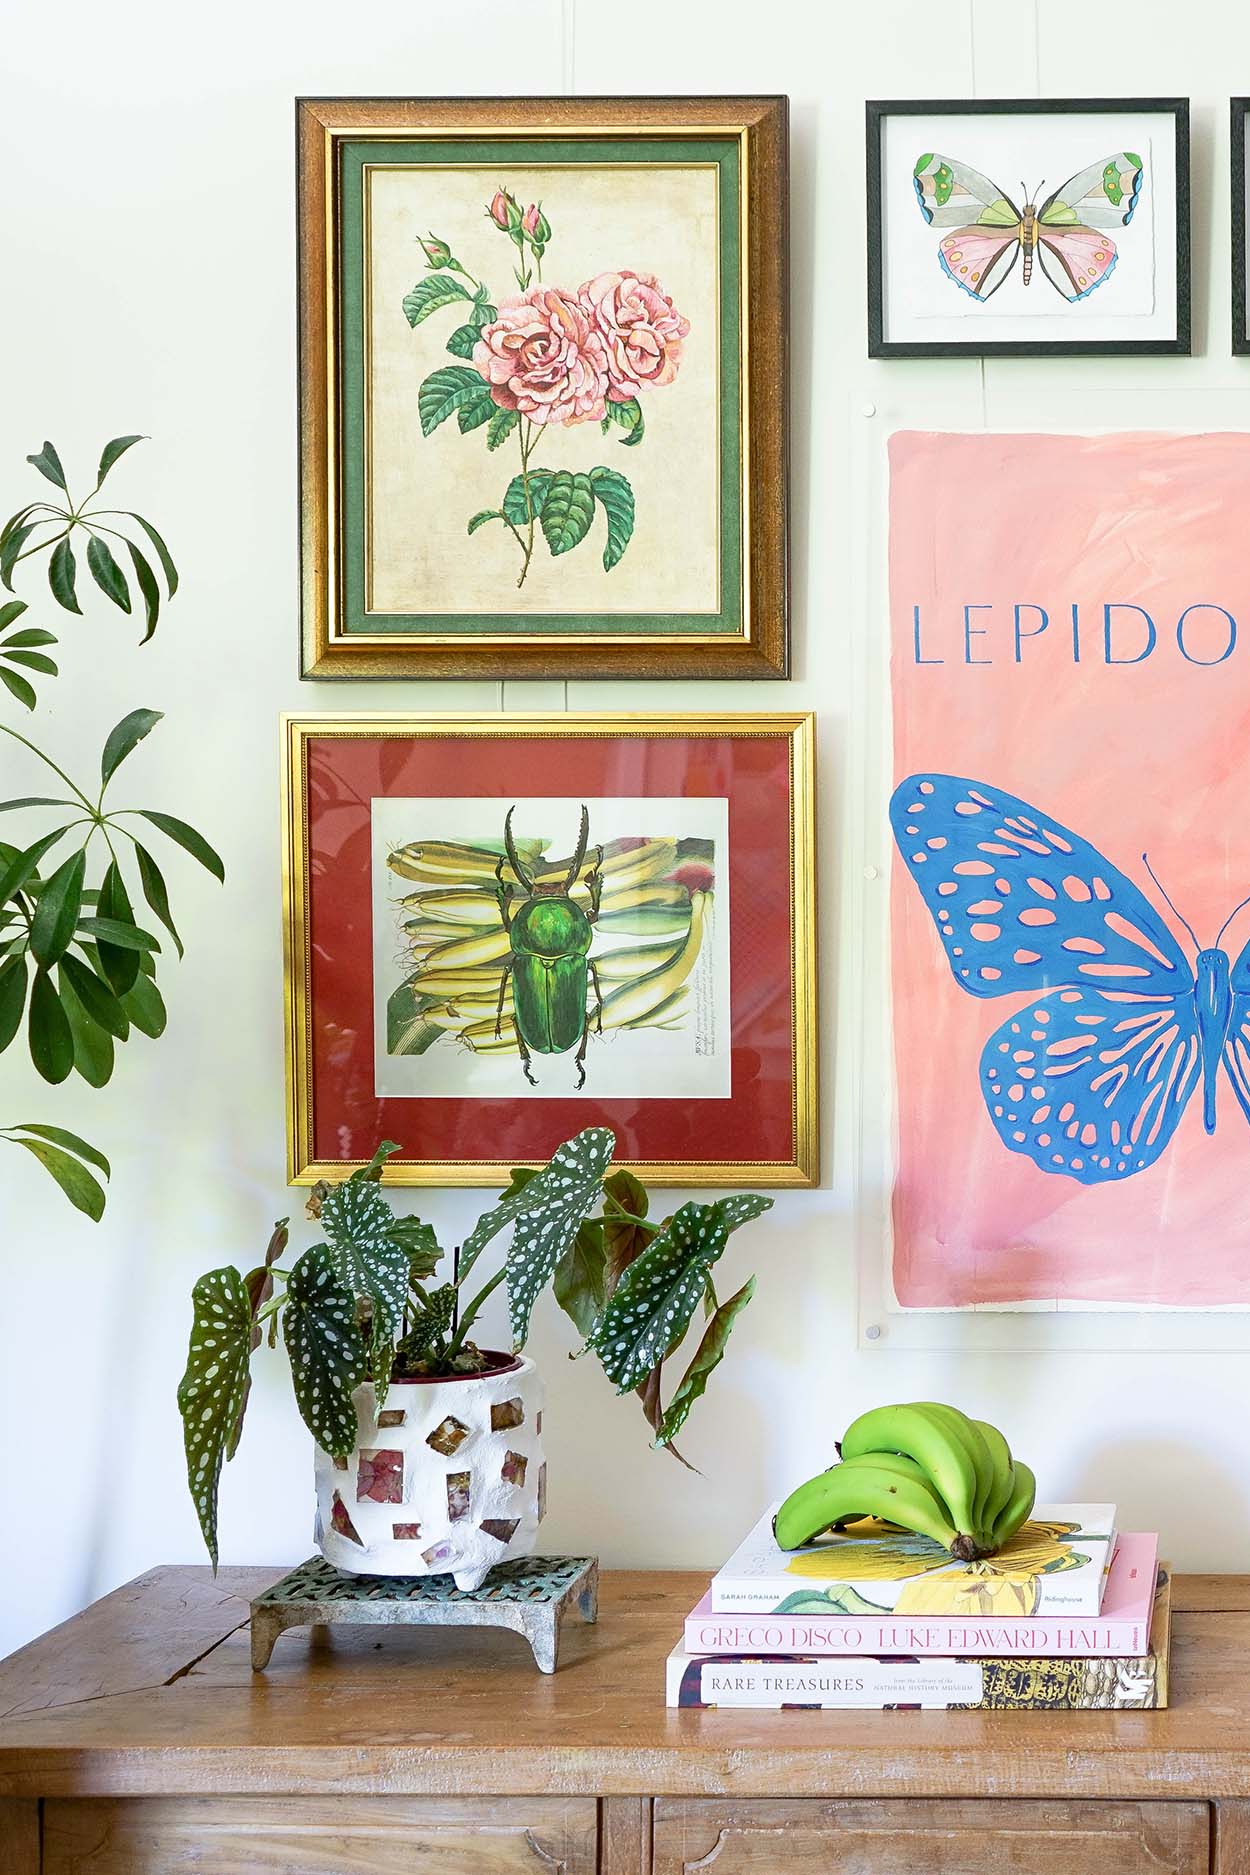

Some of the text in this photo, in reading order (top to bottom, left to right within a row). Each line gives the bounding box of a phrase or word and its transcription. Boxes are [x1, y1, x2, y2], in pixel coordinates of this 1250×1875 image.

[699, 1627, 1120, 1649] GRECO DISCO LUKE EDWARD HALL
[711, 1677, 865, 1691] RARE TREASURES
